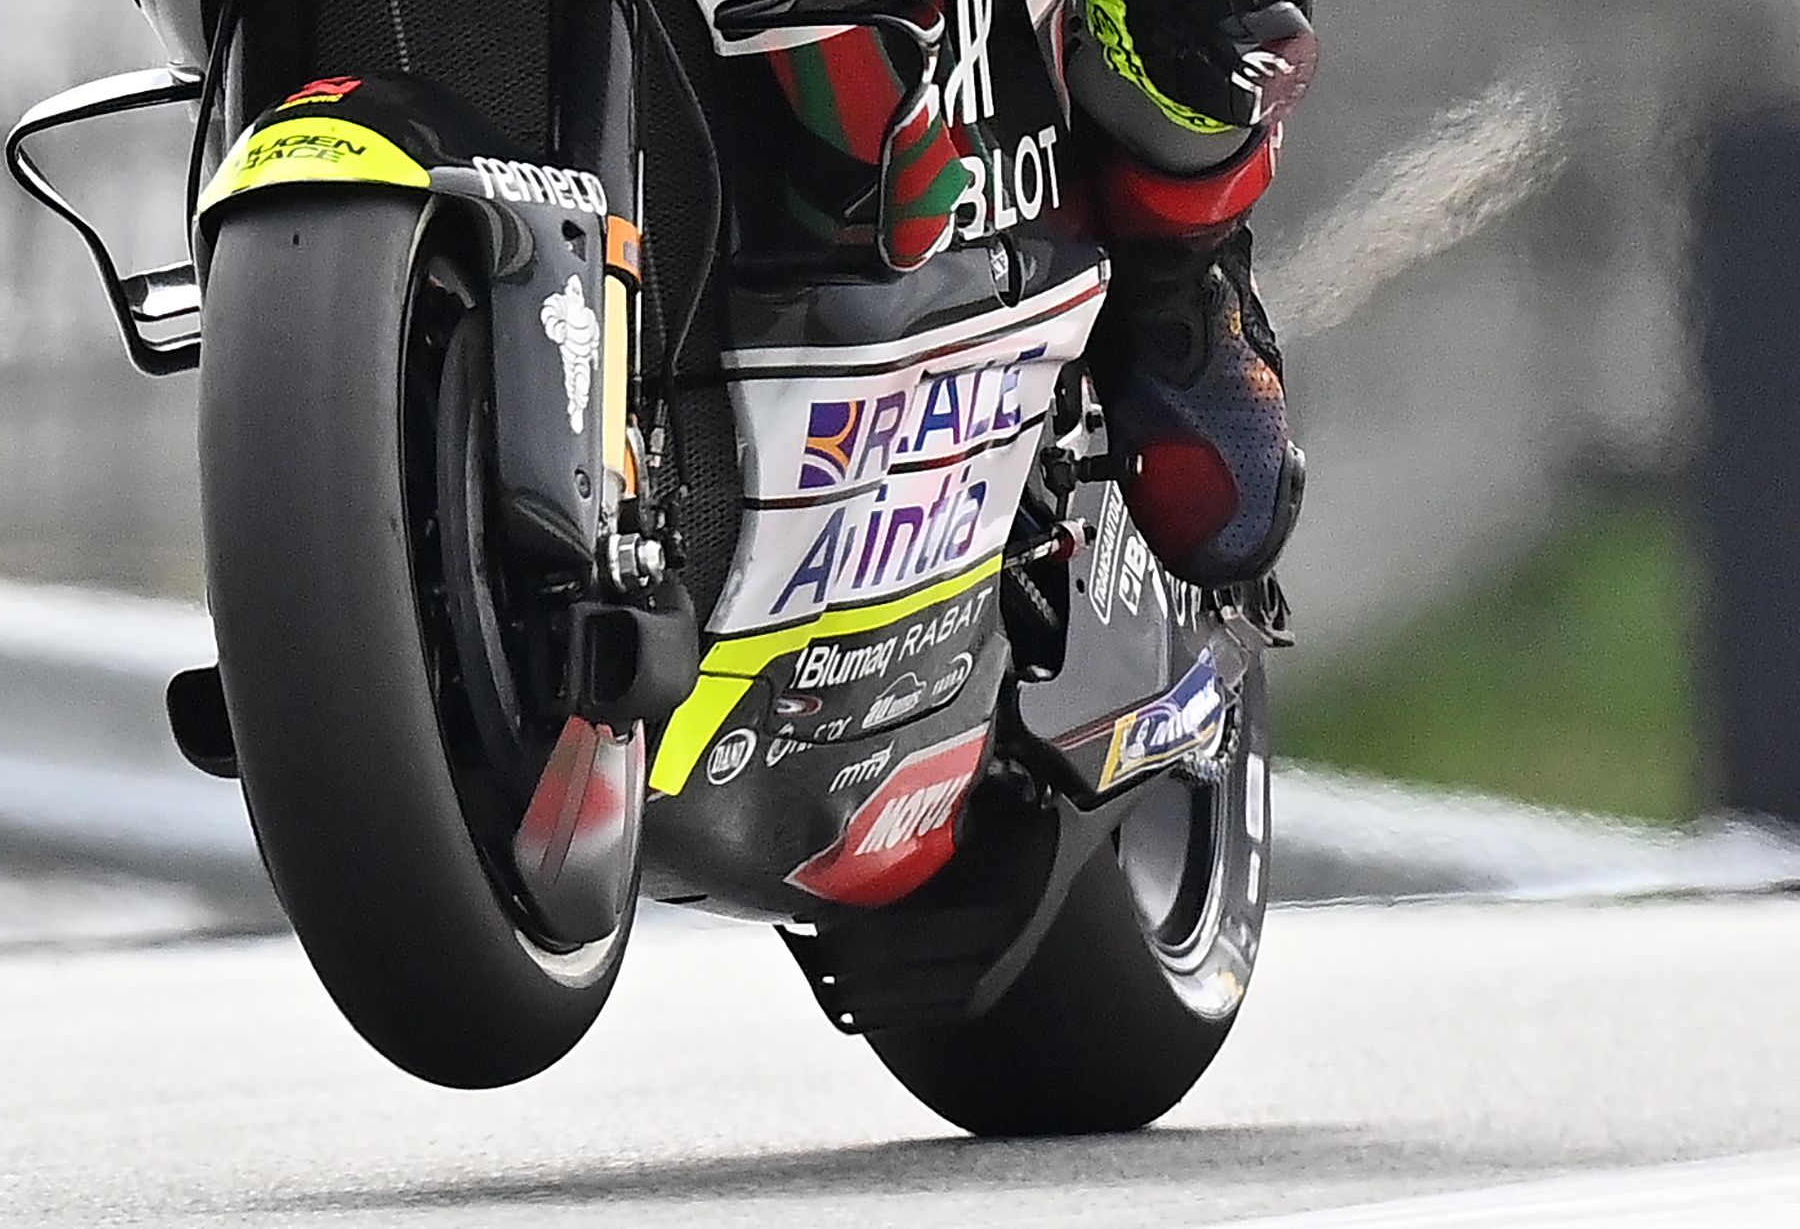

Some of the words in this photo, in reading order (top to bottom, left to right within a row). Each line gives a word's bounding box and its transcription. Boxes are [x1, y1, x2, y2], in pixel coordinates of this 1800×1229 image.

[950, 124, 1061, 242] BLOT
[854, 341, 1048, 481] RALE
[797, 636, 899, 690] Blumaq
[898, 586, 994, 661] RABAT
